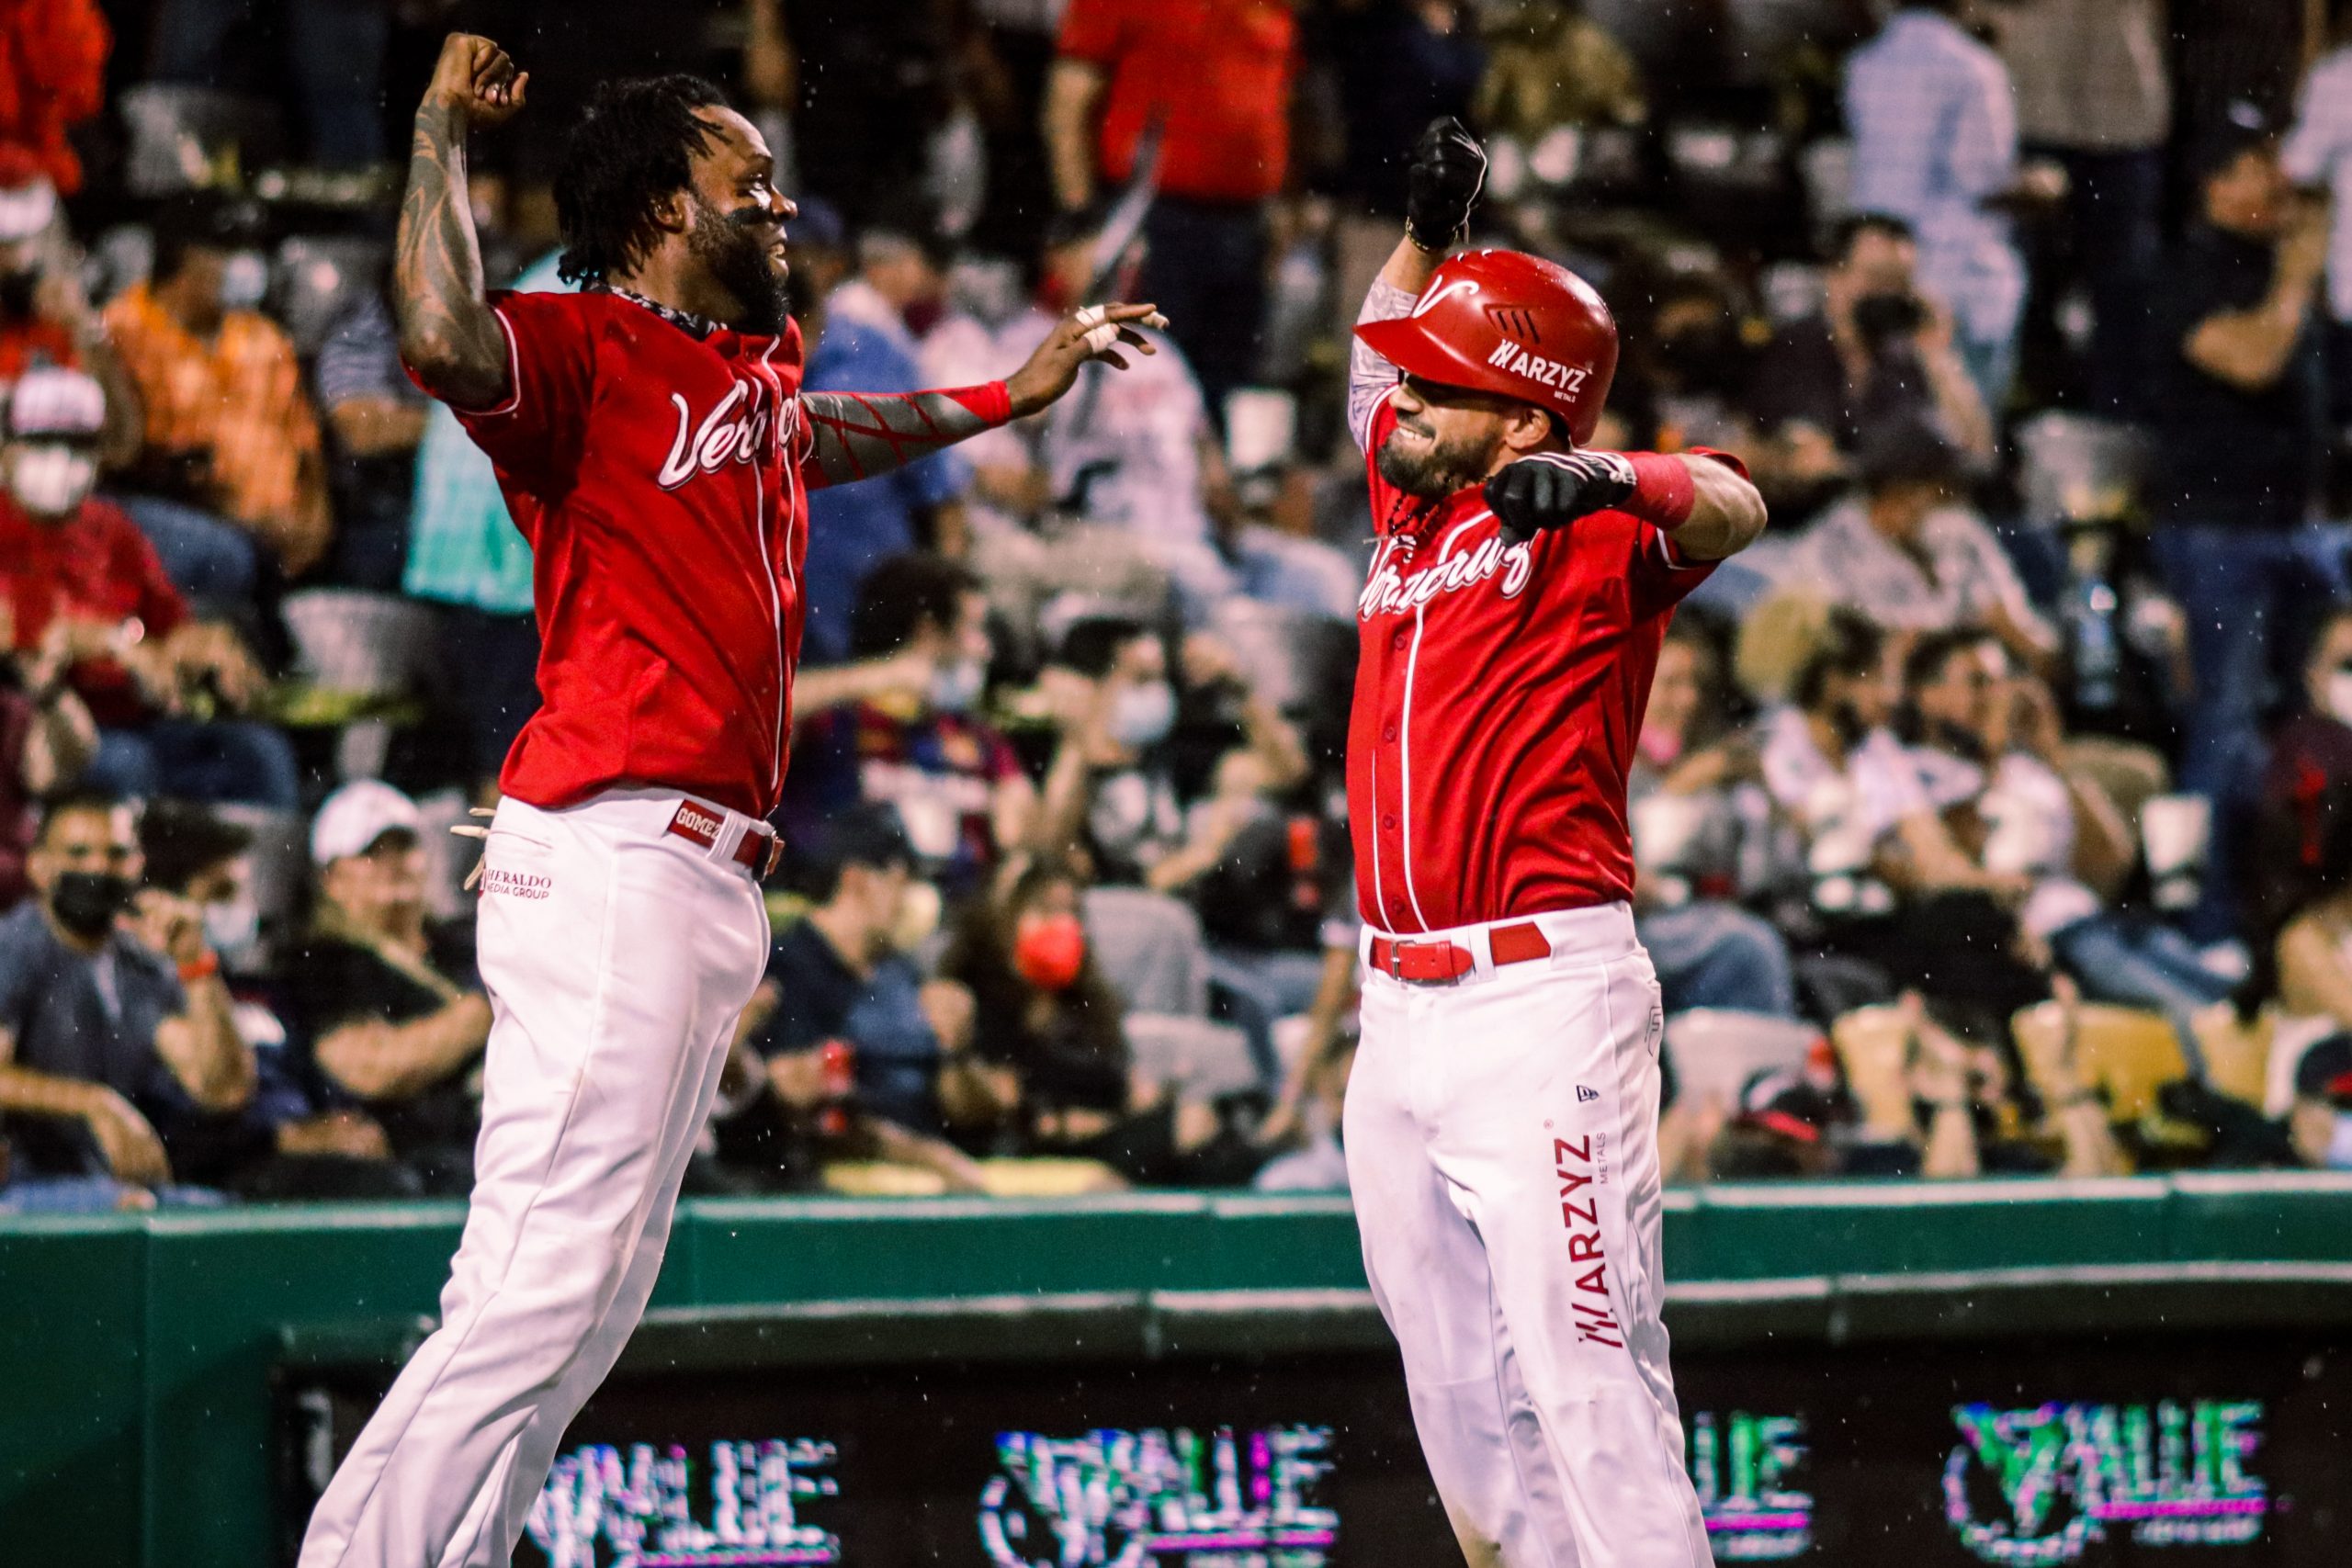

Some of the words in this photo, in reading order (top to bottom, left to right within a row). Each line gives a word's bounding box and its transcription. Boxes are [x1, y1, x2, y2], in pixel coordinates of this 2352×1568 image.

[487, 869, 552, 889] HERALDO
[513, 886, 549, 899] GROUP
[1596, 1132, 1608, 1184] METALS
